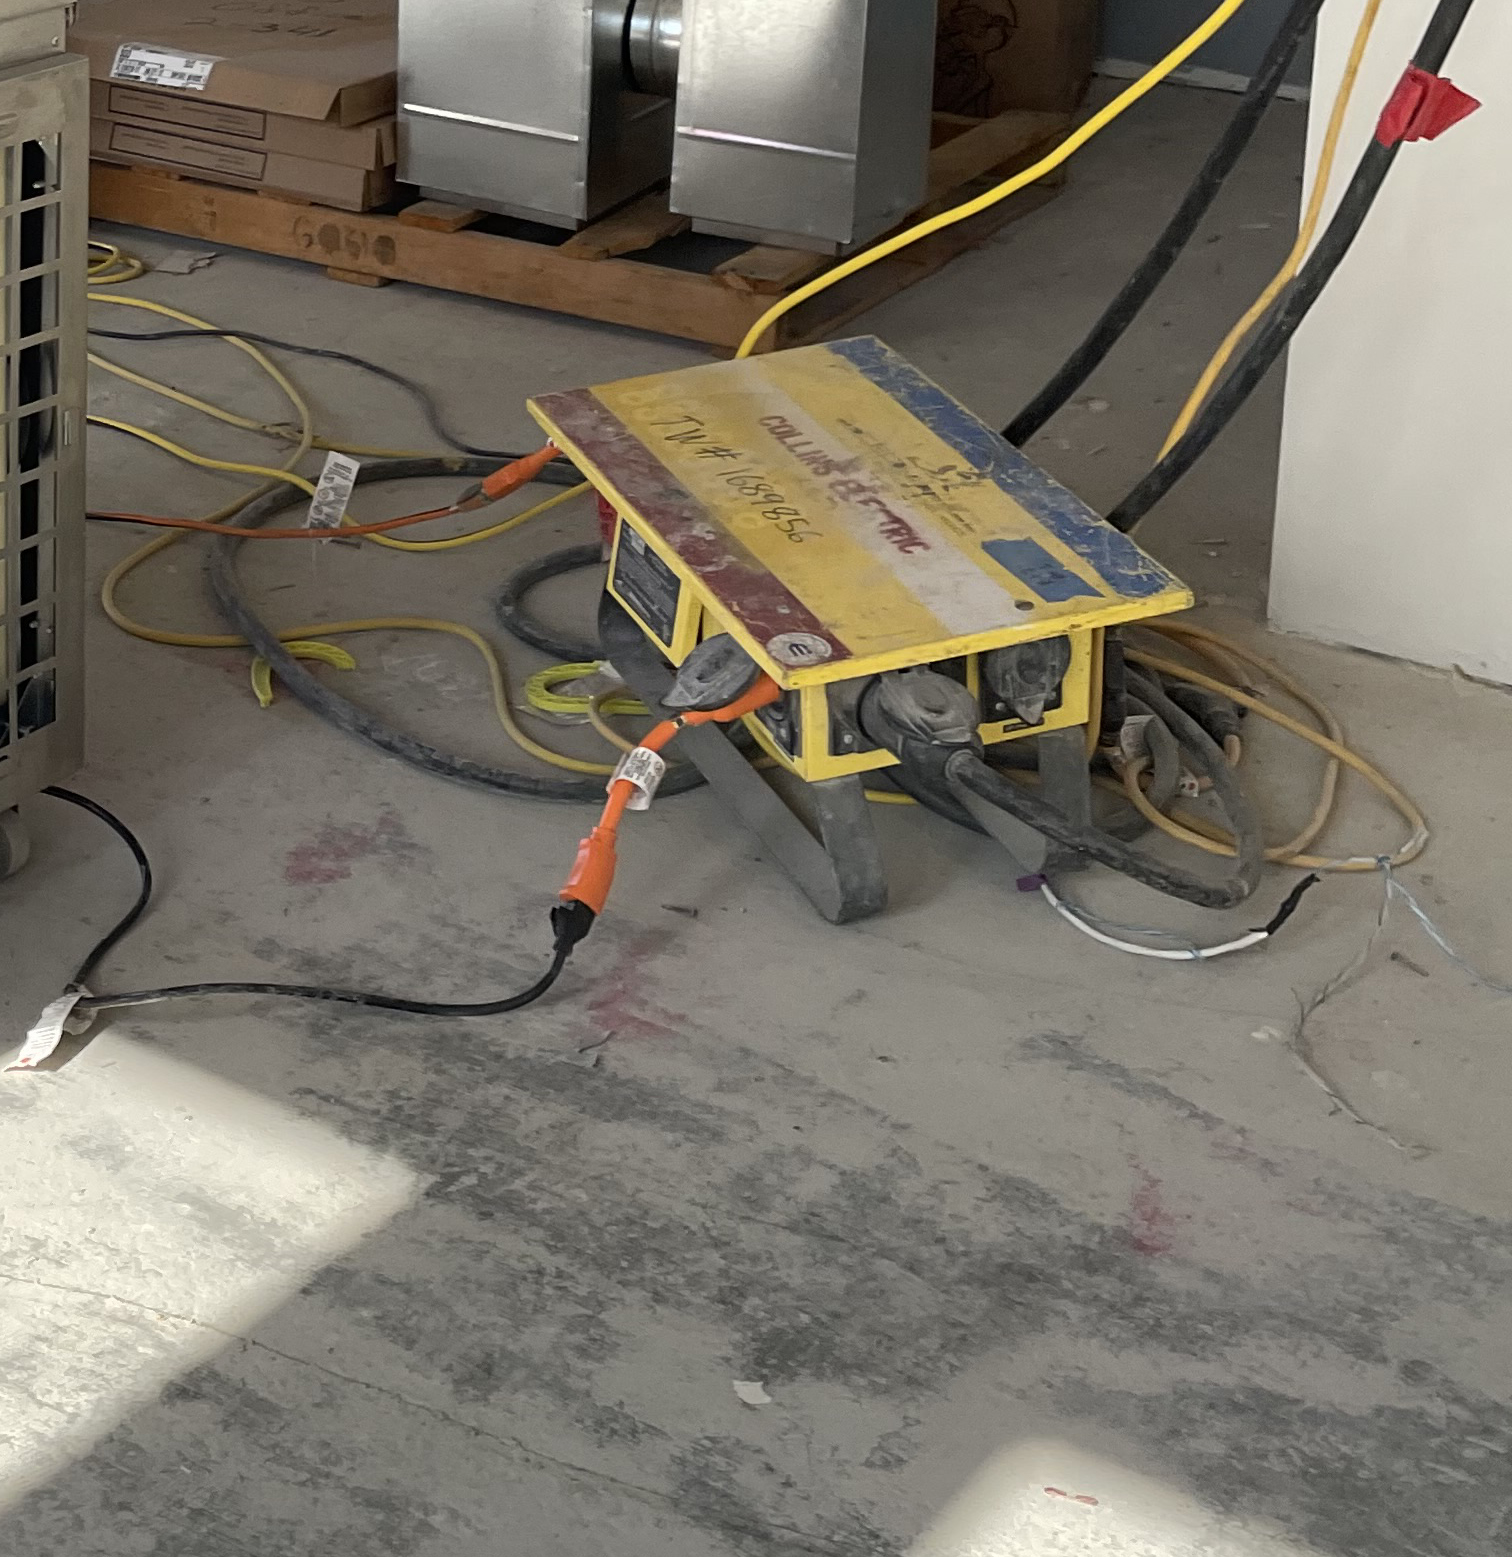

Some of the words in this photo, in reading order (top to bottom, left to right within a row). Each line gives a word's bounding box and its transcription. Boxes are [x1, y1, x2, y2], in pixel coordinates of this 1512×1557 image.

[649, 414, 744, 462] TW#
[715, 467, 824, 545] 1689856
[757, 414, 838, 477] COLLINS
